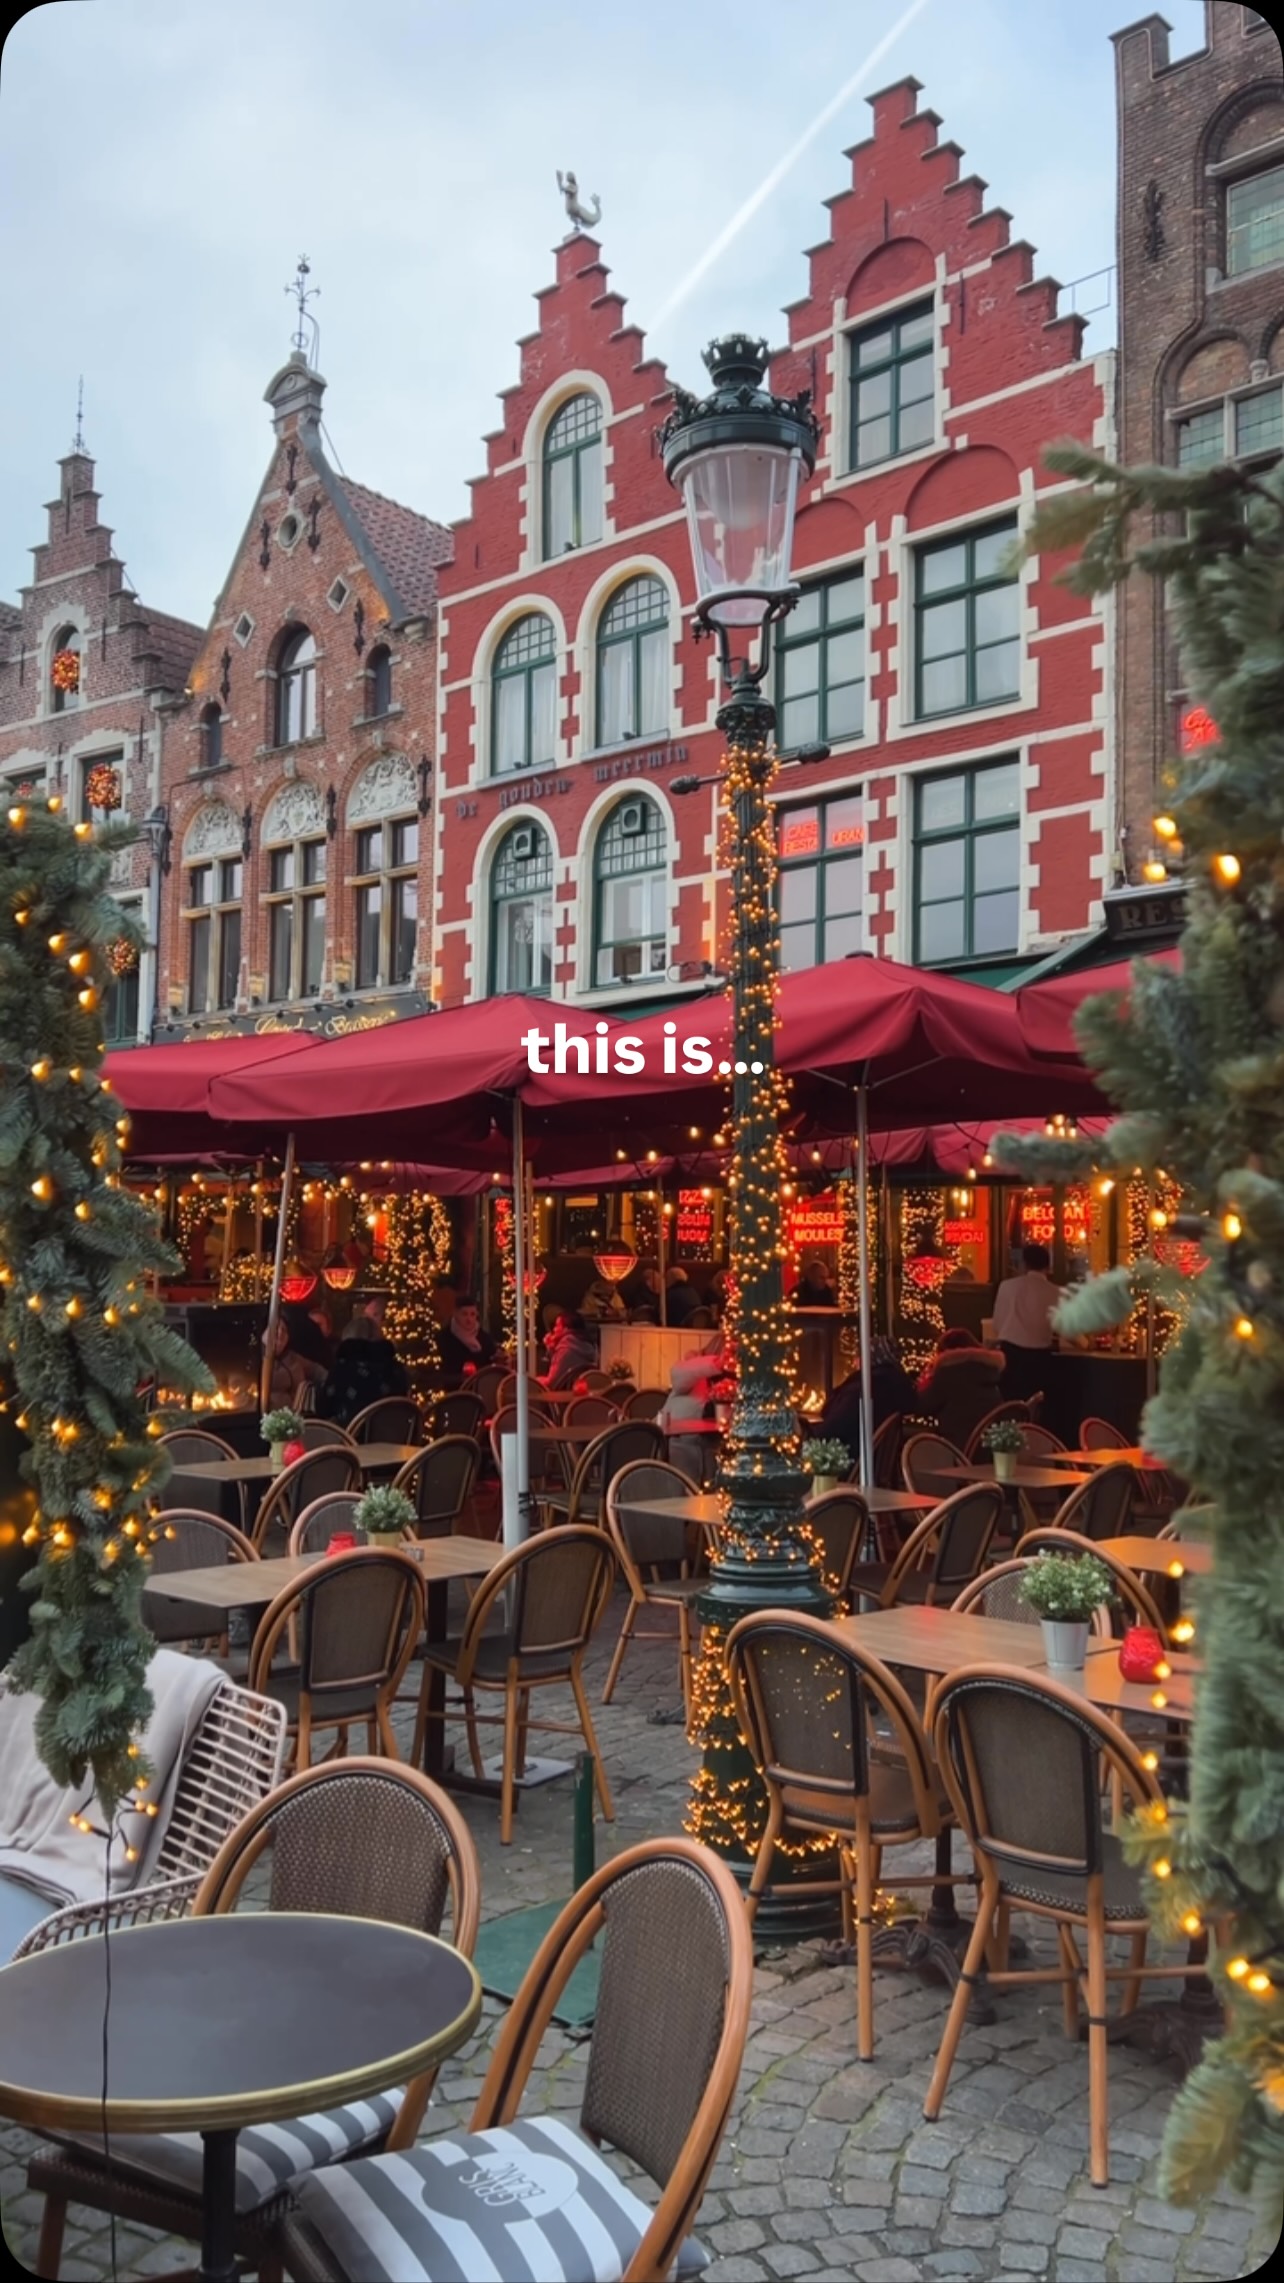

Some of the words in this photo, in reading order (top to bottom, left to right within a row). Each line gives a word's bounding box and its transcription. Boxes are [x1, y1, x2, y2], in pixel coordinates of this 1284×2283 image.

[499, 777, 570, 810] gouden
[594, 744, 687, 782] meermin
[794, 1227, 844, 1241] MOULES
